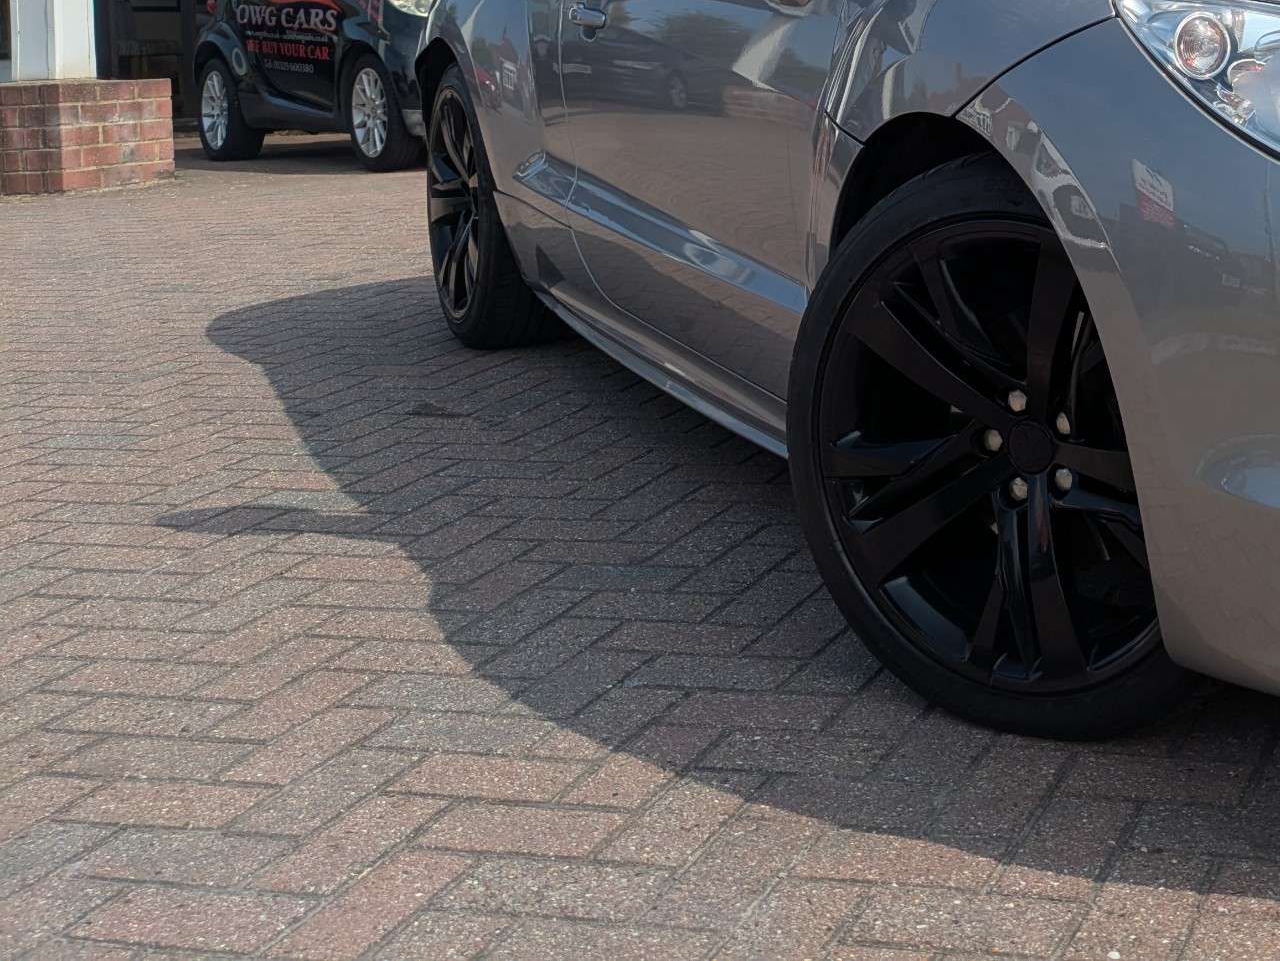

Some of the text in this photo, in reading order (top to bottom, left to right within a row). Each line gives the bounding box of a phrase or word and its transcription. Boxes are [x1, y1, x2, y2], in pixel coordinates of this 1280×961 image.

[236, 4, 338, 32] OWG CARS
[278, 41, 306, 59] YOUR
[307, 45, 330, 60] CAR
